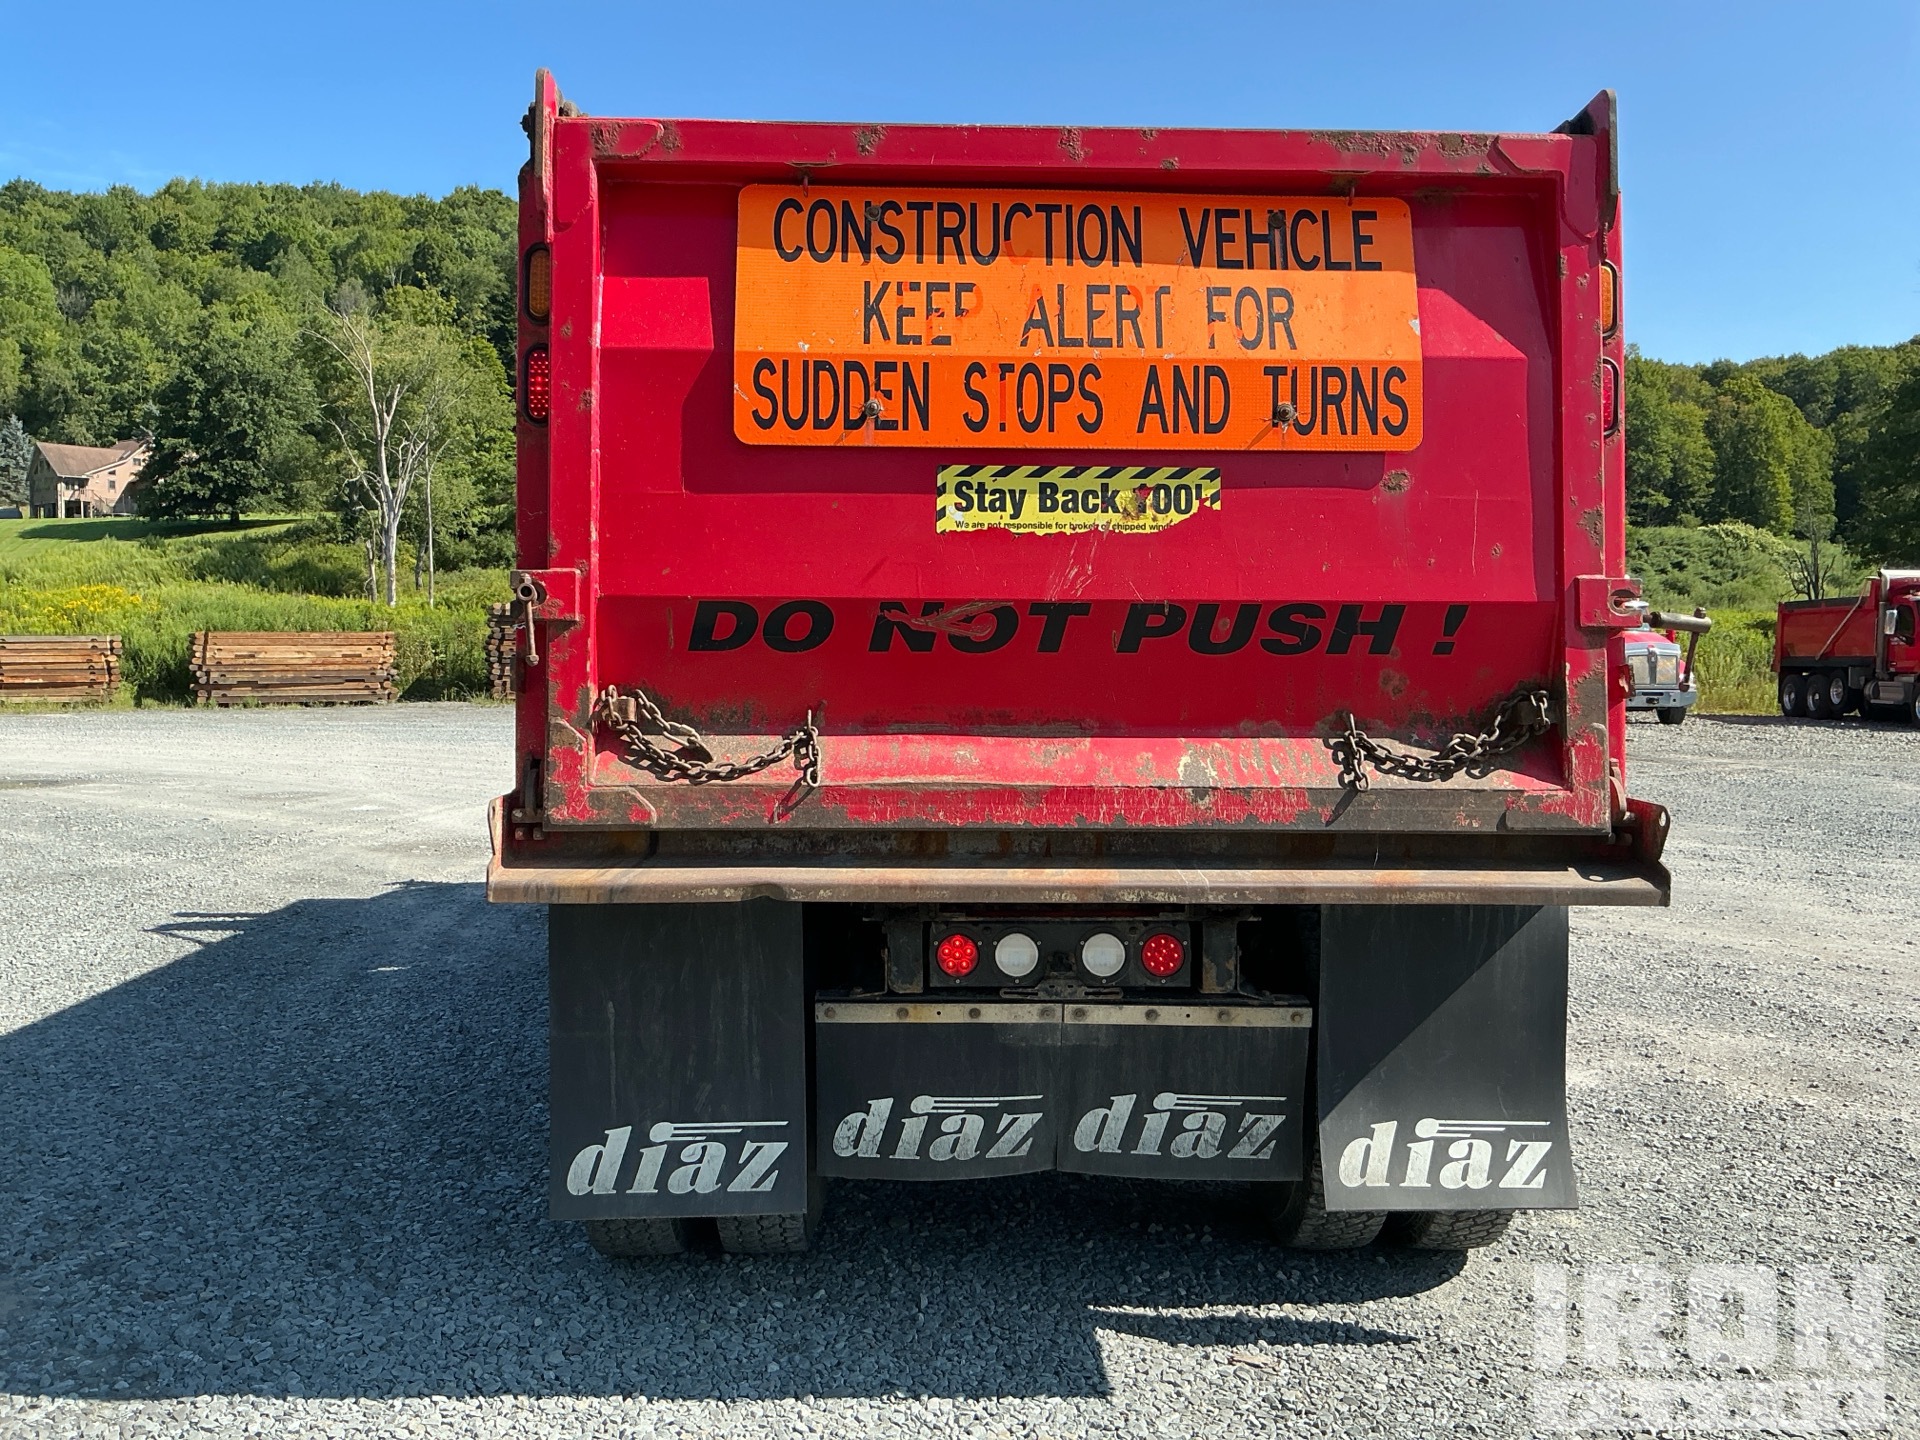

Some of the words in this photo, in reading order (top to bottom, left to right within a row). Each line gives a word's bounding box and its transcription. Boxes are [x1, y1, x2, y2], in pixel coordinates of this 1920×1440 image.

[773, 197, 1143, 268] CONSTRUCTION
[1178, 207, 1383, 272] VEHICLE
[863, 280, 984, 346] KEEP
[1019, 283, 1171, 349] ALERT
[1206, 286, 1298, 351] FOR
[752, 357, 930, 433] SUDDEN
[962, 361, 1104, 434] STOPS
[1136, 364, 1232, 435] AND
[1263, 366, 1409, 437] TURNS
[953, 480, 1026, 520] Stay
[1038, 481, 1121, 515] Back
[955, 520, 969, 529] We
[971, 521, 985, 529] are
[987, 521, 1002, 529] not
[1004, 521, 1053, 531] responsible
[1055, 522, 1067, 530] for
[1112, 522, 1147, 531] chipped
[687, 601, 837, 654] DO
[868, 601, 1093, 654] NOT
[1114, 602, 1407, 657] PUSH
[566, 1121, 789, 1196] diaz
[832, 1094, 1044, 1161] diaz
[1073, 1092, 1287, 1160] diaz
[1338, 1118, 1553, 1190] diaz
